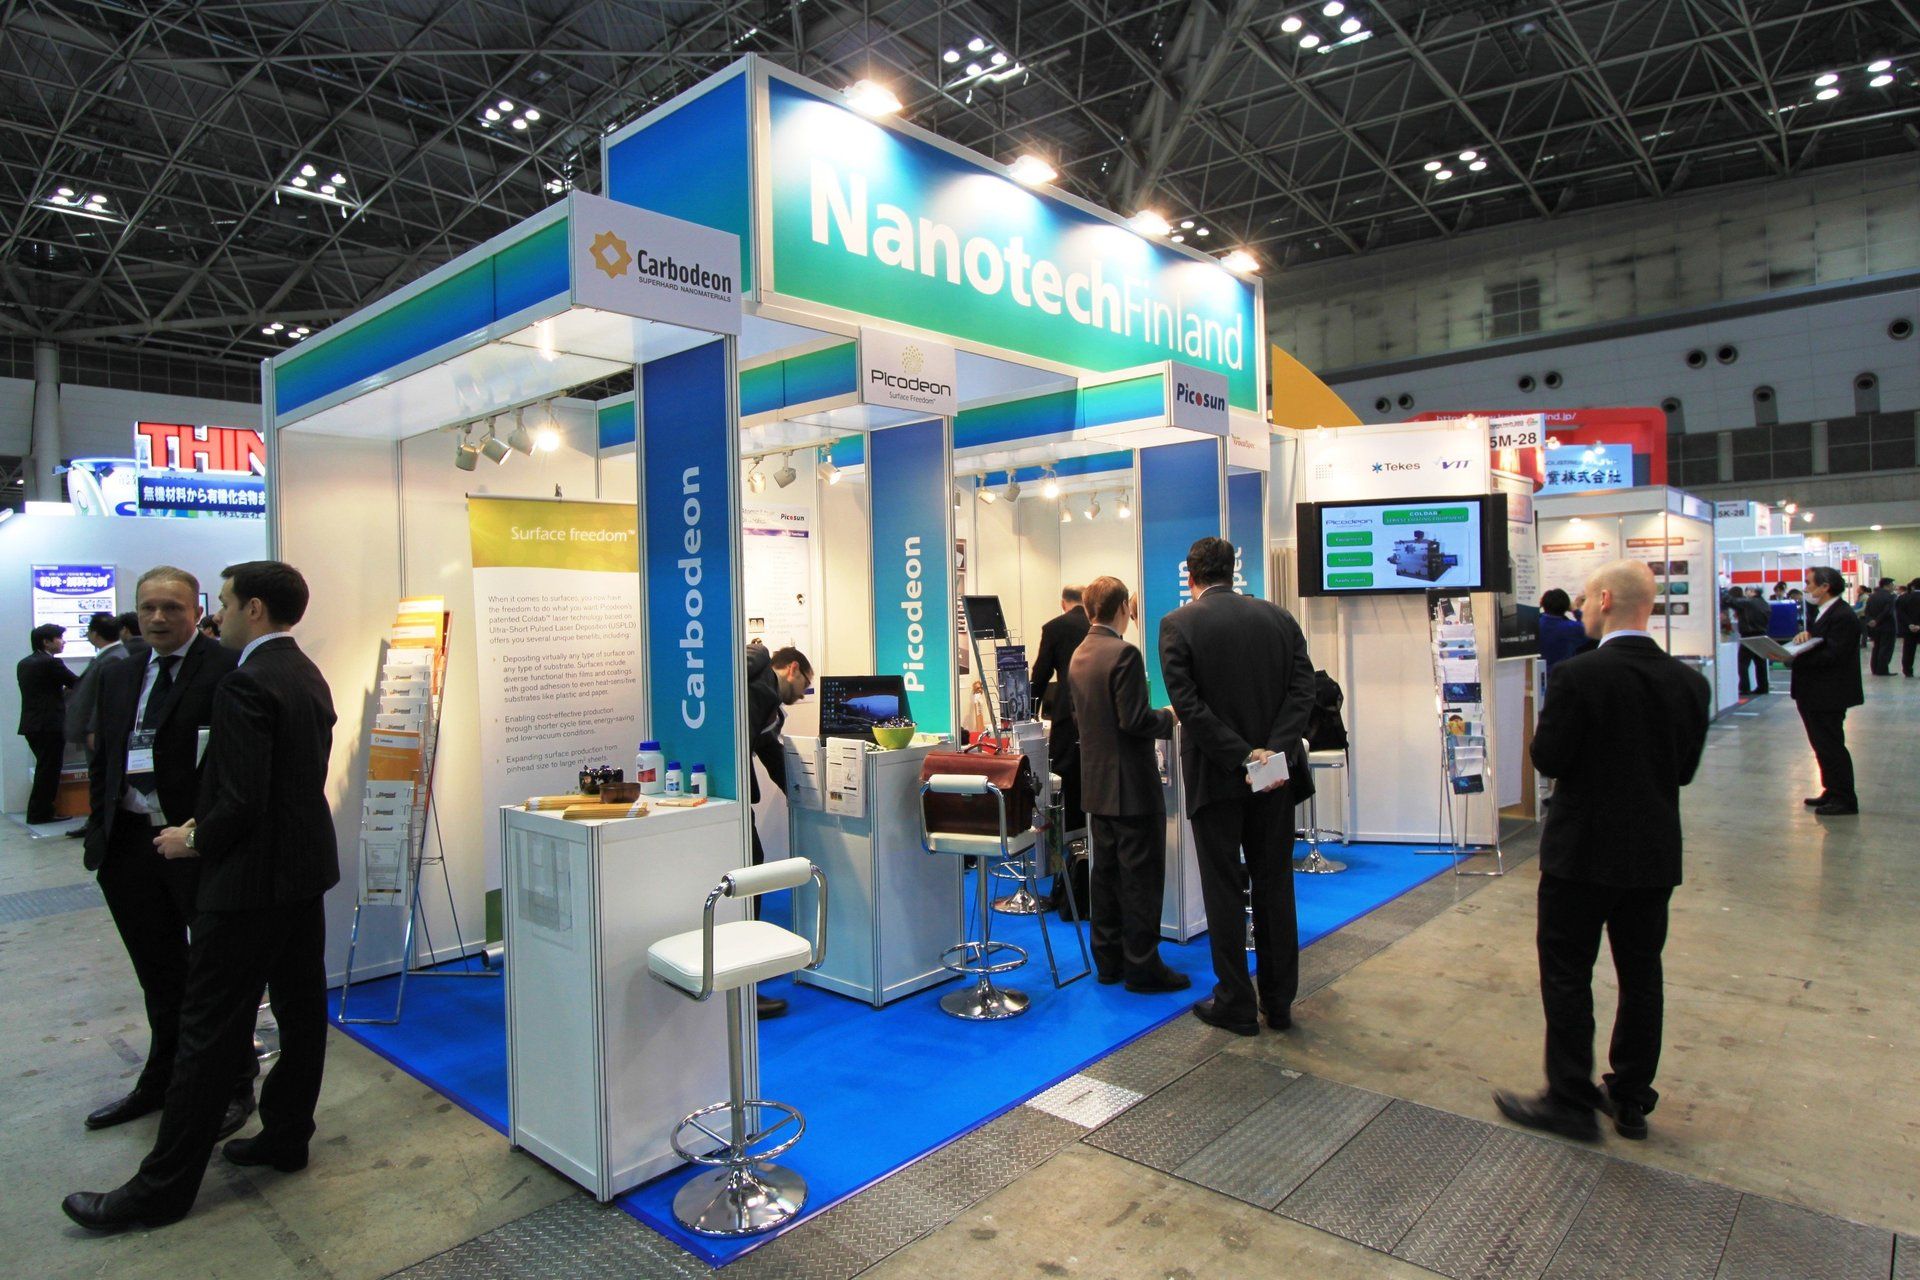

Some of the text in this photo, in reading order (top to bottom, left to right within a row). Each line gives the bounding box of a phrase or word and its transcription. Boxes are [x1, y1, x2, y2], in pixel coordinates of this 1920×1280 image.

[637, 249, 732, 293] Carbodeon
[638, 276, 731, 303] SUPERHARD NANOMATERIALS
[871, 369, 951, 396] Picodeon
[889, 391, 910, 401] Surface
[1177, 383, 1225, 411] Picosun
[1490, 432, 1537, 449] 5M-28
[1385, 462, 1420, 471] Tekes
[781, 513, 805, 521] Picosun
[511, 526, 566, 541] Surface
[678, 466, 706, 730] Carbodeon
[489, 616, 519, 624] patented
[570, 614, 603, 622] technology
[901, 536, 925, 692] Picodeon
[489, 626, 528, 634] Ultra-Short
[576, 623, 608, 631] Deposition
[503, 655, 540, 663] Depositing
[503, 666, 515, 674] any
[518, 665, 532, 673] type
[531, 673, 563, 681] functional
[607, 668, 632, 676] coatings
[521, 685, 538, 693] good
[596, 677, 636, 686] heat-sensitive
[556, 692, 576, 700] plastic
[505, 708, 614, 723] Enabling cost-effective production
[505, 725, 532, 734] through
[594, 714, 635, 724] energy-saving
[521, 732, 562, 741] low-vacuum
[506, 753, 542, 763] Expanding
[545, 750, 569, 759] surface
[571, 746, 603, 756] production
[506, 765, 535, 775] pinhead
[560, 760, 576, 768] large
